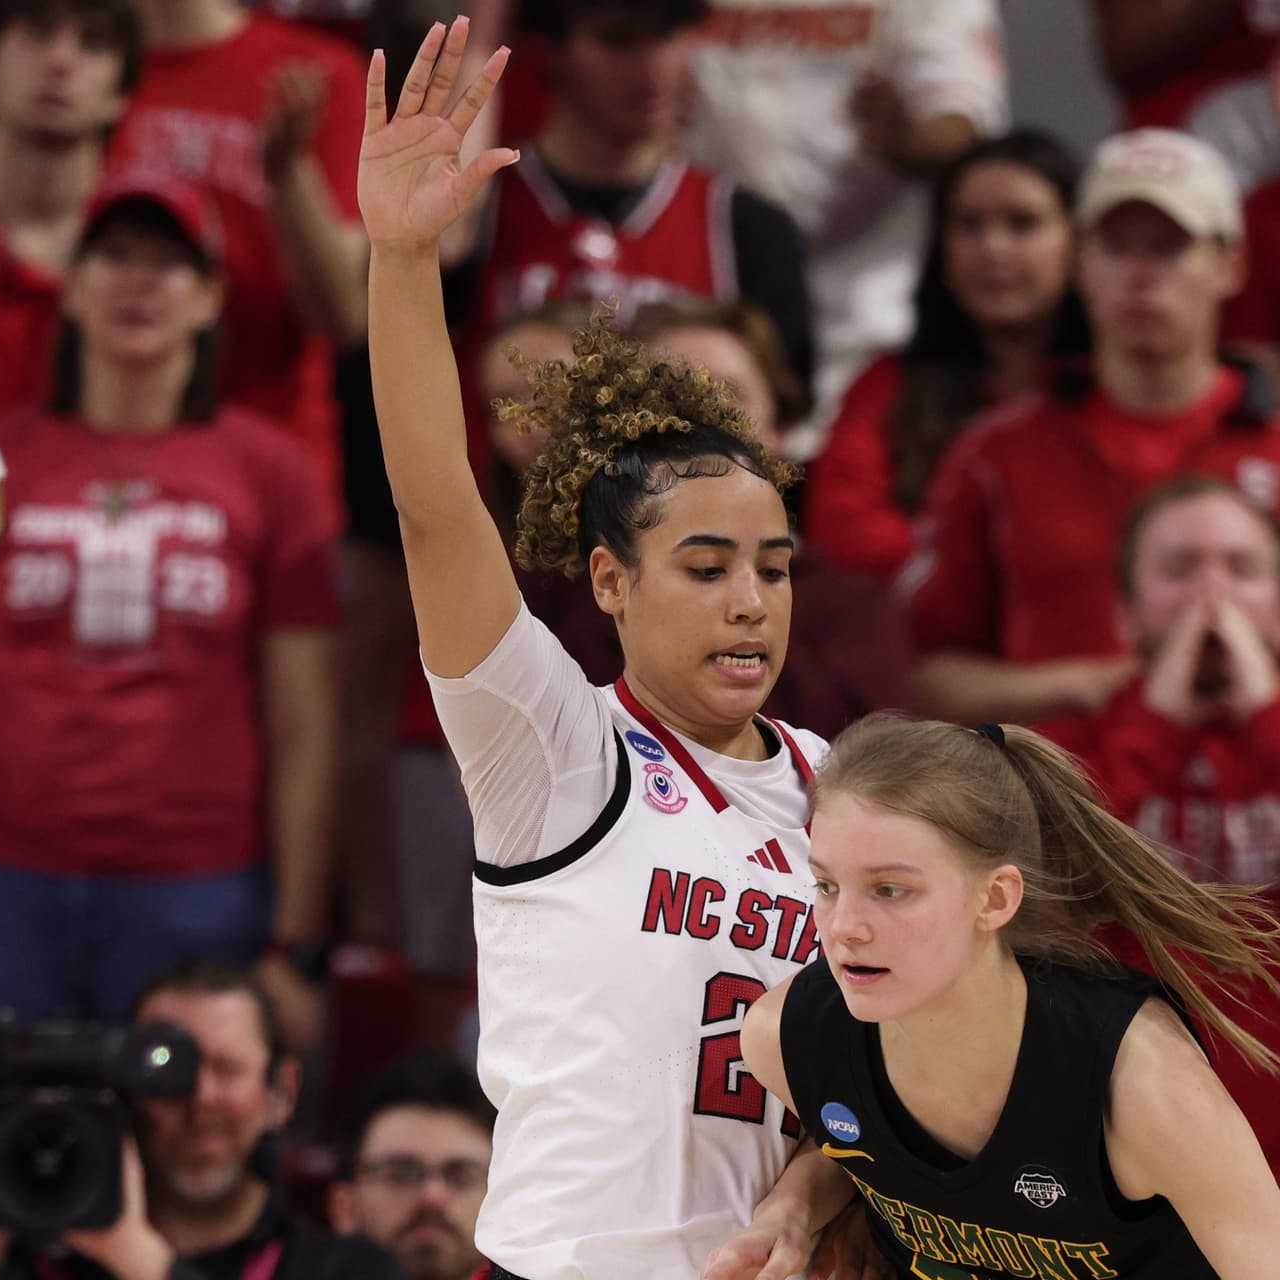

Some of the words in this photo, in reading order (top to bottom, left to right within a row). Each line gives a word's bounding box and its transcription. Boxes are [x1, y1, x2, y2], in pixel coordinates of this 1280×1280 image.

[641, 867, 726, 941] NC
[729, 888, 826, 965] STA
[693, 970, 801, 1140] 2
[827, 1119, 860, 1136] NCAA
[1014, 1180, 1067, 1197] AMERICA
[1027, 1190, 1057, 1200] EAST
